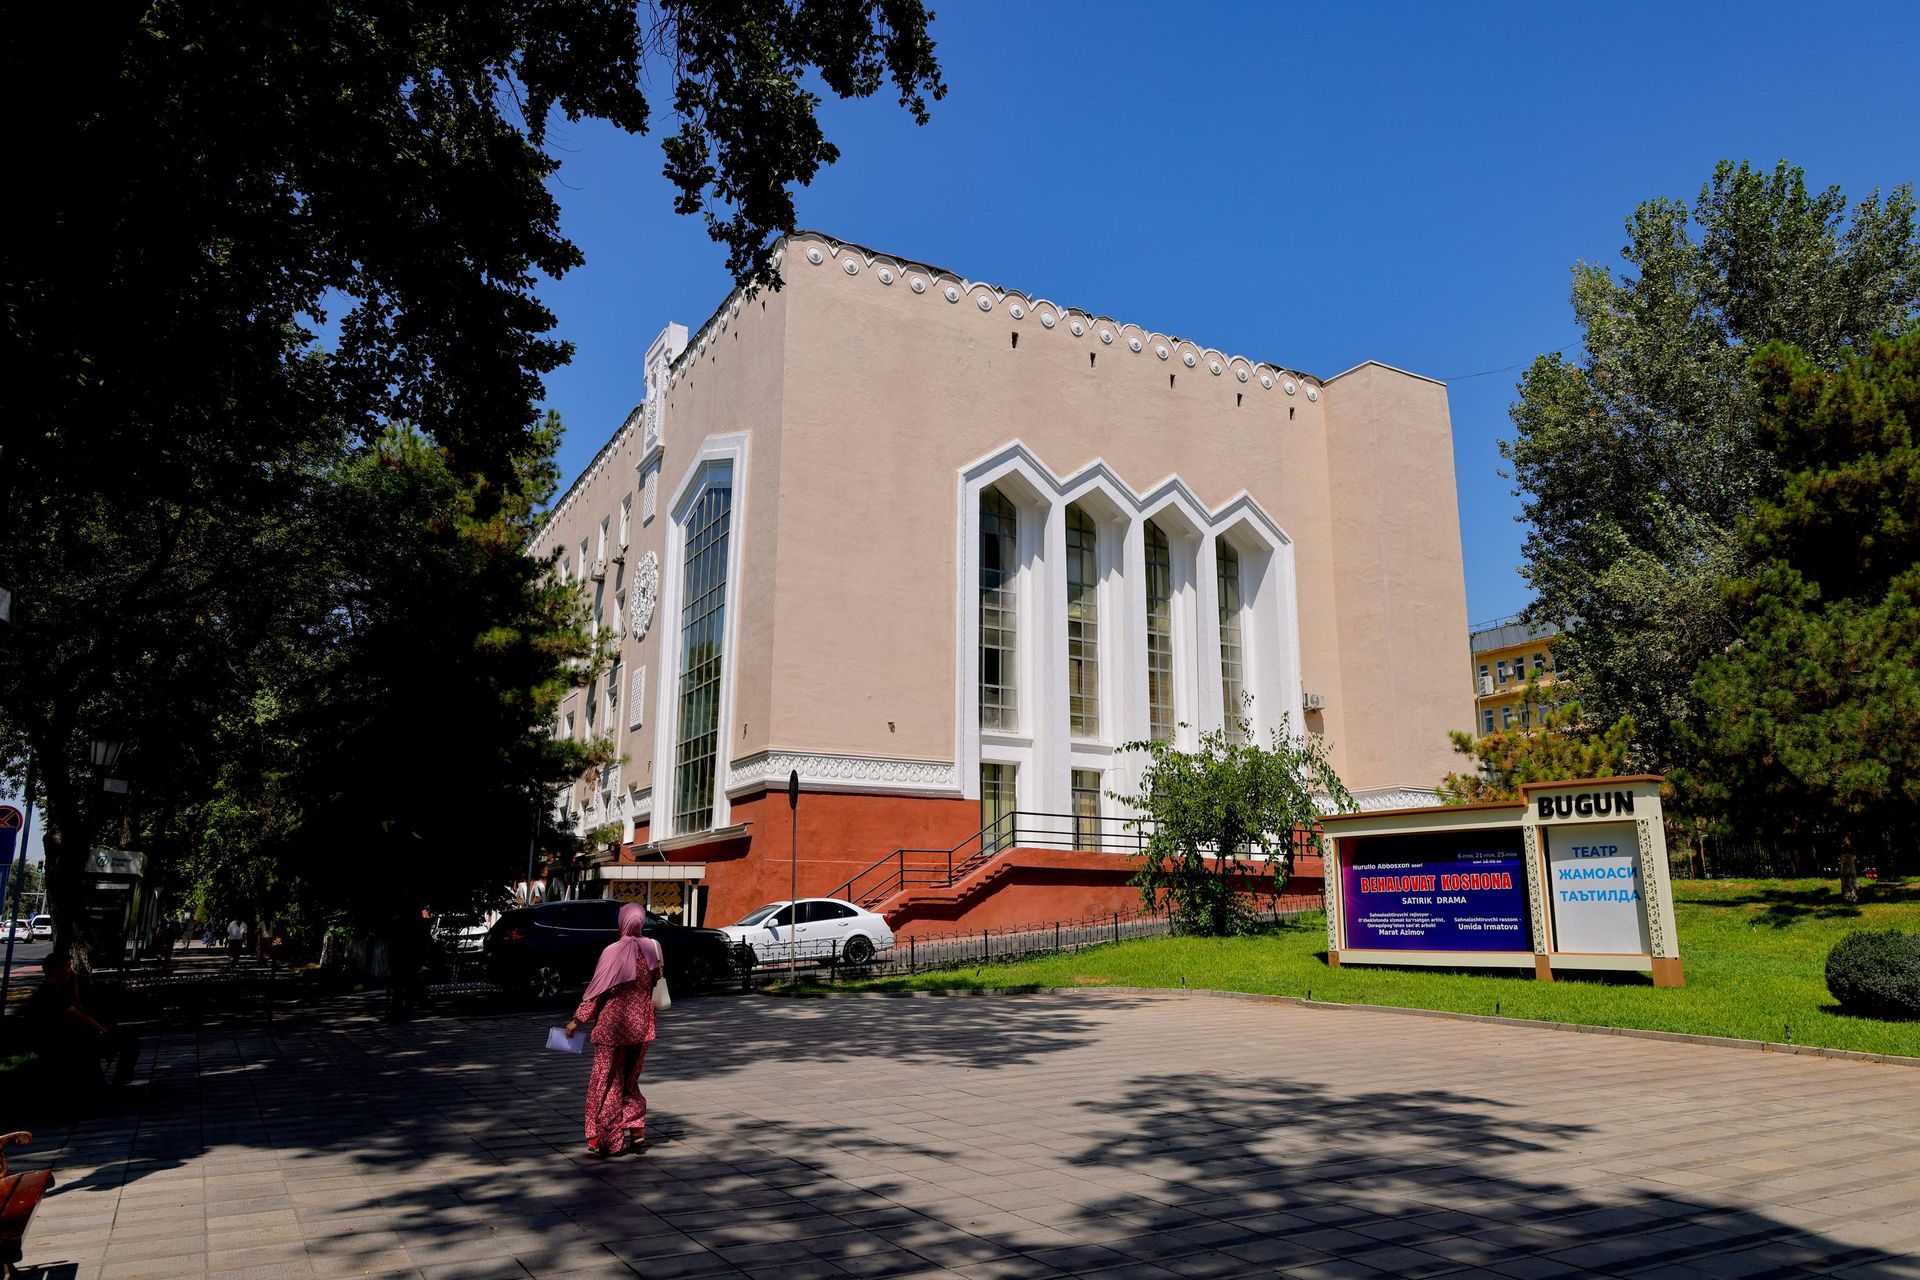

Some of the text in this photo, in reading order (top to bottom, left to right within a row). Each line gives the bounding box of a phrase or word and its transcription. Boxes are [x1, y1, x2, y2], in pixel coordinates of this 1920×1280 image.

[1538, 791, 1635, 818] BUGUN
[1572, 846, 1618, 858] ТЕАТР
[1558, 867, 1638, 880] ЖАМОАСИ
[1360, 872, 1512, 893] BEHALOVAT KOSHONA
[1560, 890, 1642, 903] ТАЪТИЛДА
